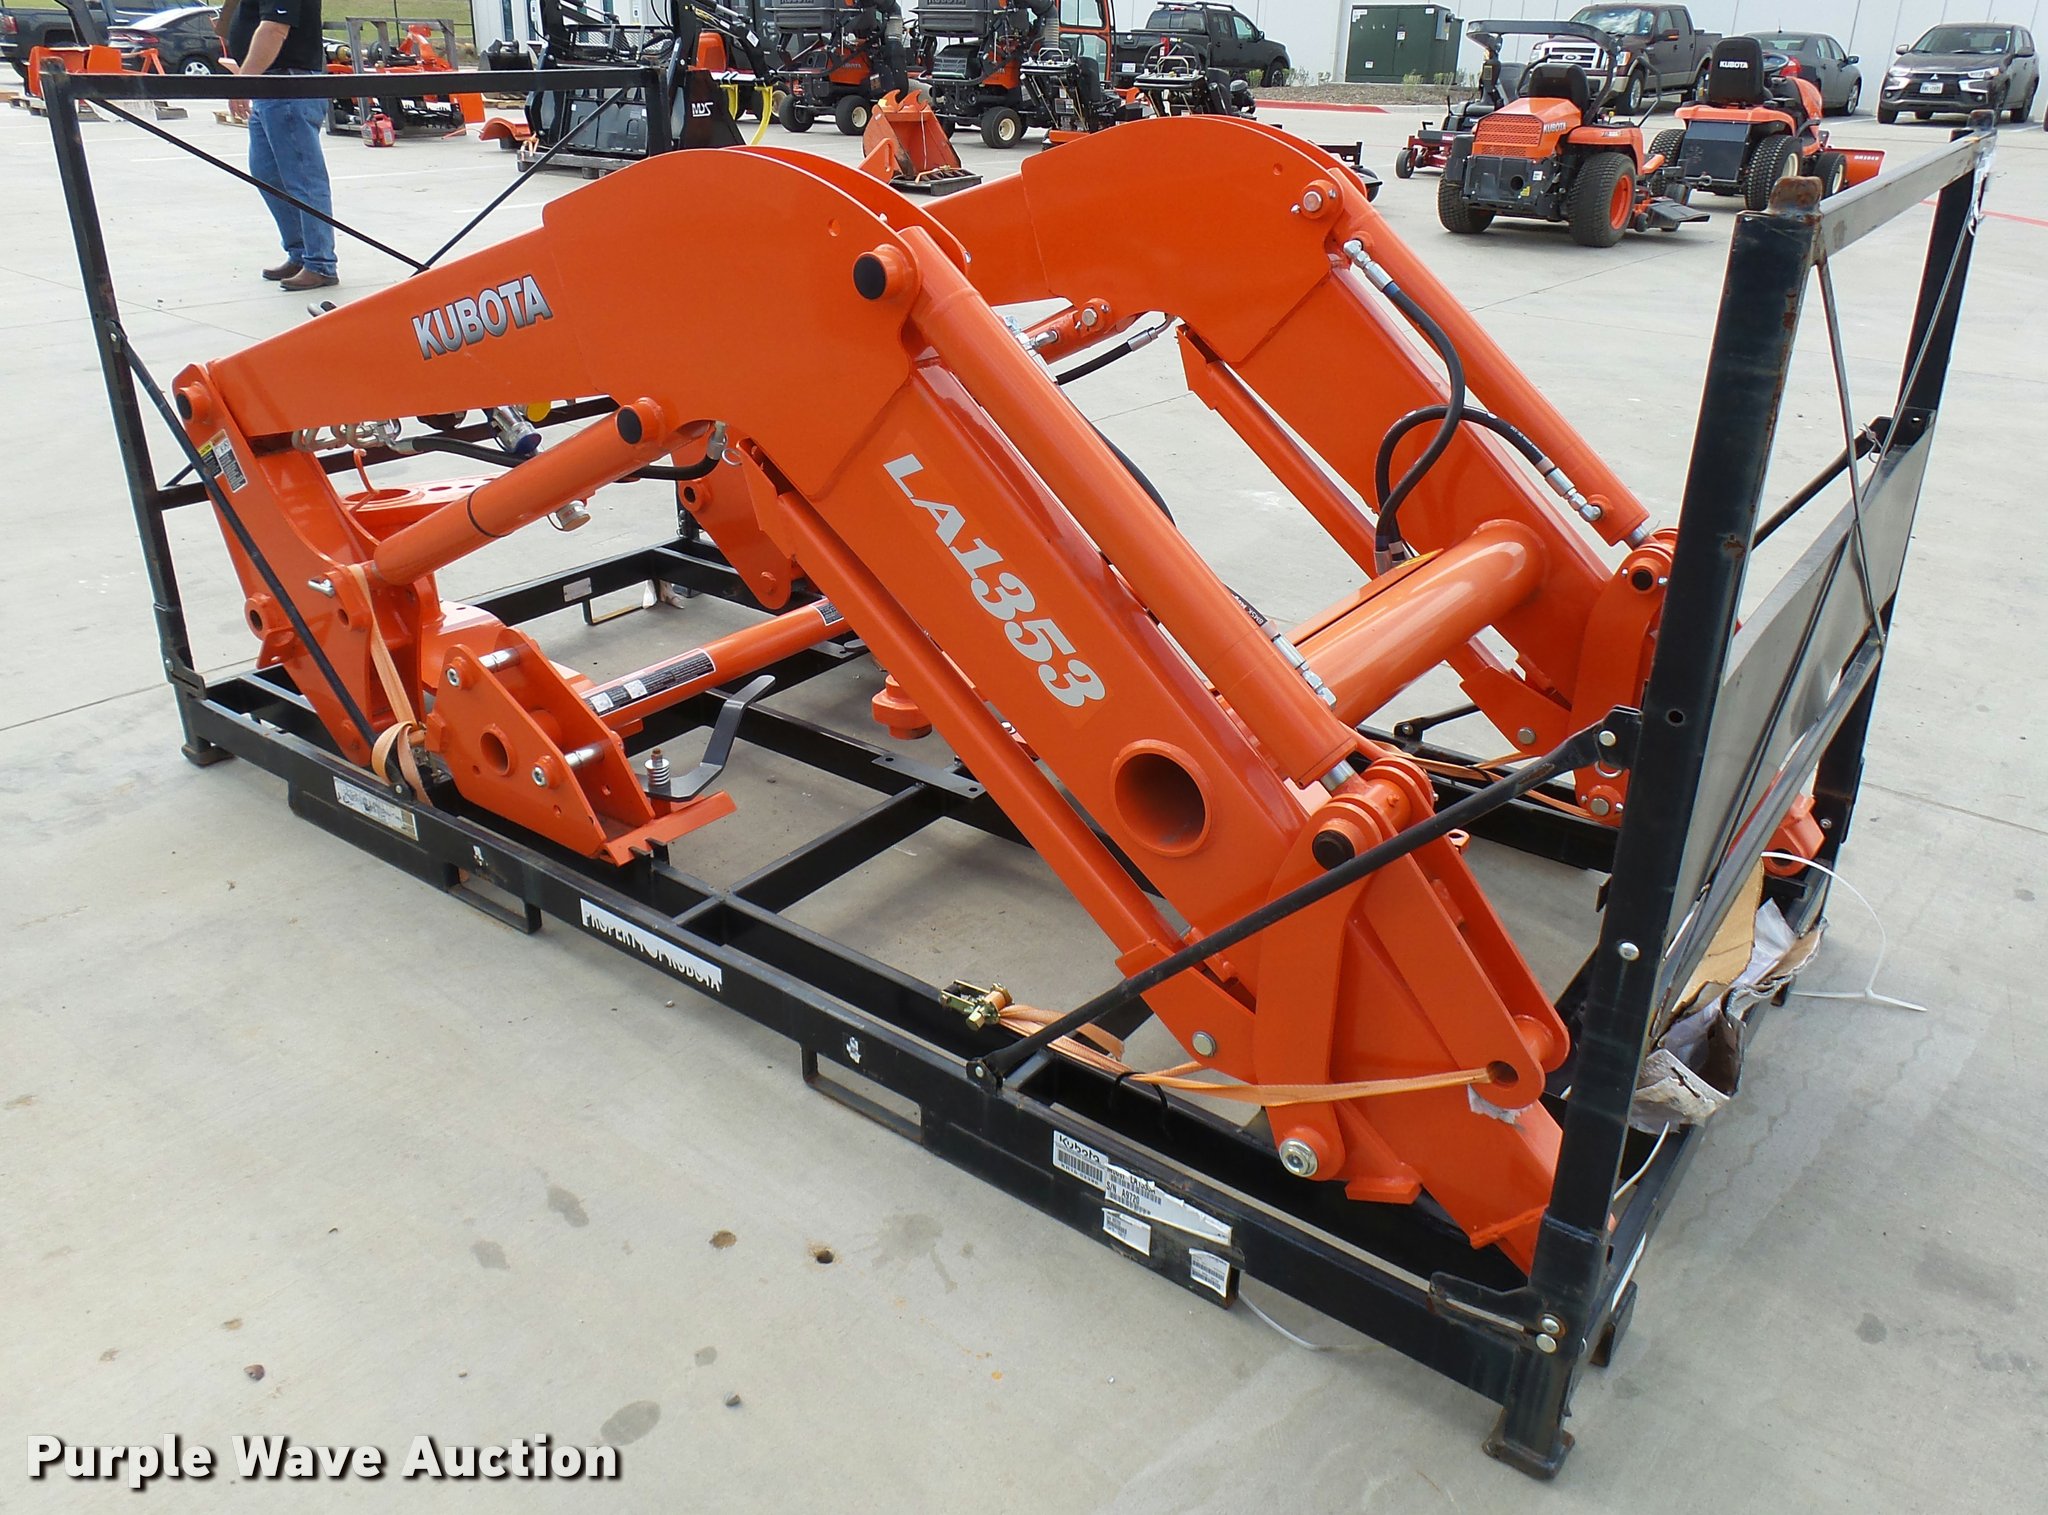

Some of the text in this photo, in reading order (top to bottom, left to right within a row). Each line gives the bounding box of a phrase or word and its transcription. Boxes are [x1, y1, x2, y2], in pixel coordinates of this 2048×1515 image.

[1719, 60, 1749, 69] KUBOTA
[1543, 121, 1567, 134] KUBOTA
[411, 274, 553, 361] KUBOTA
[883, 453, 1106, 707] LA1353
[1059, 1135, 1100, 1163] Kubota
